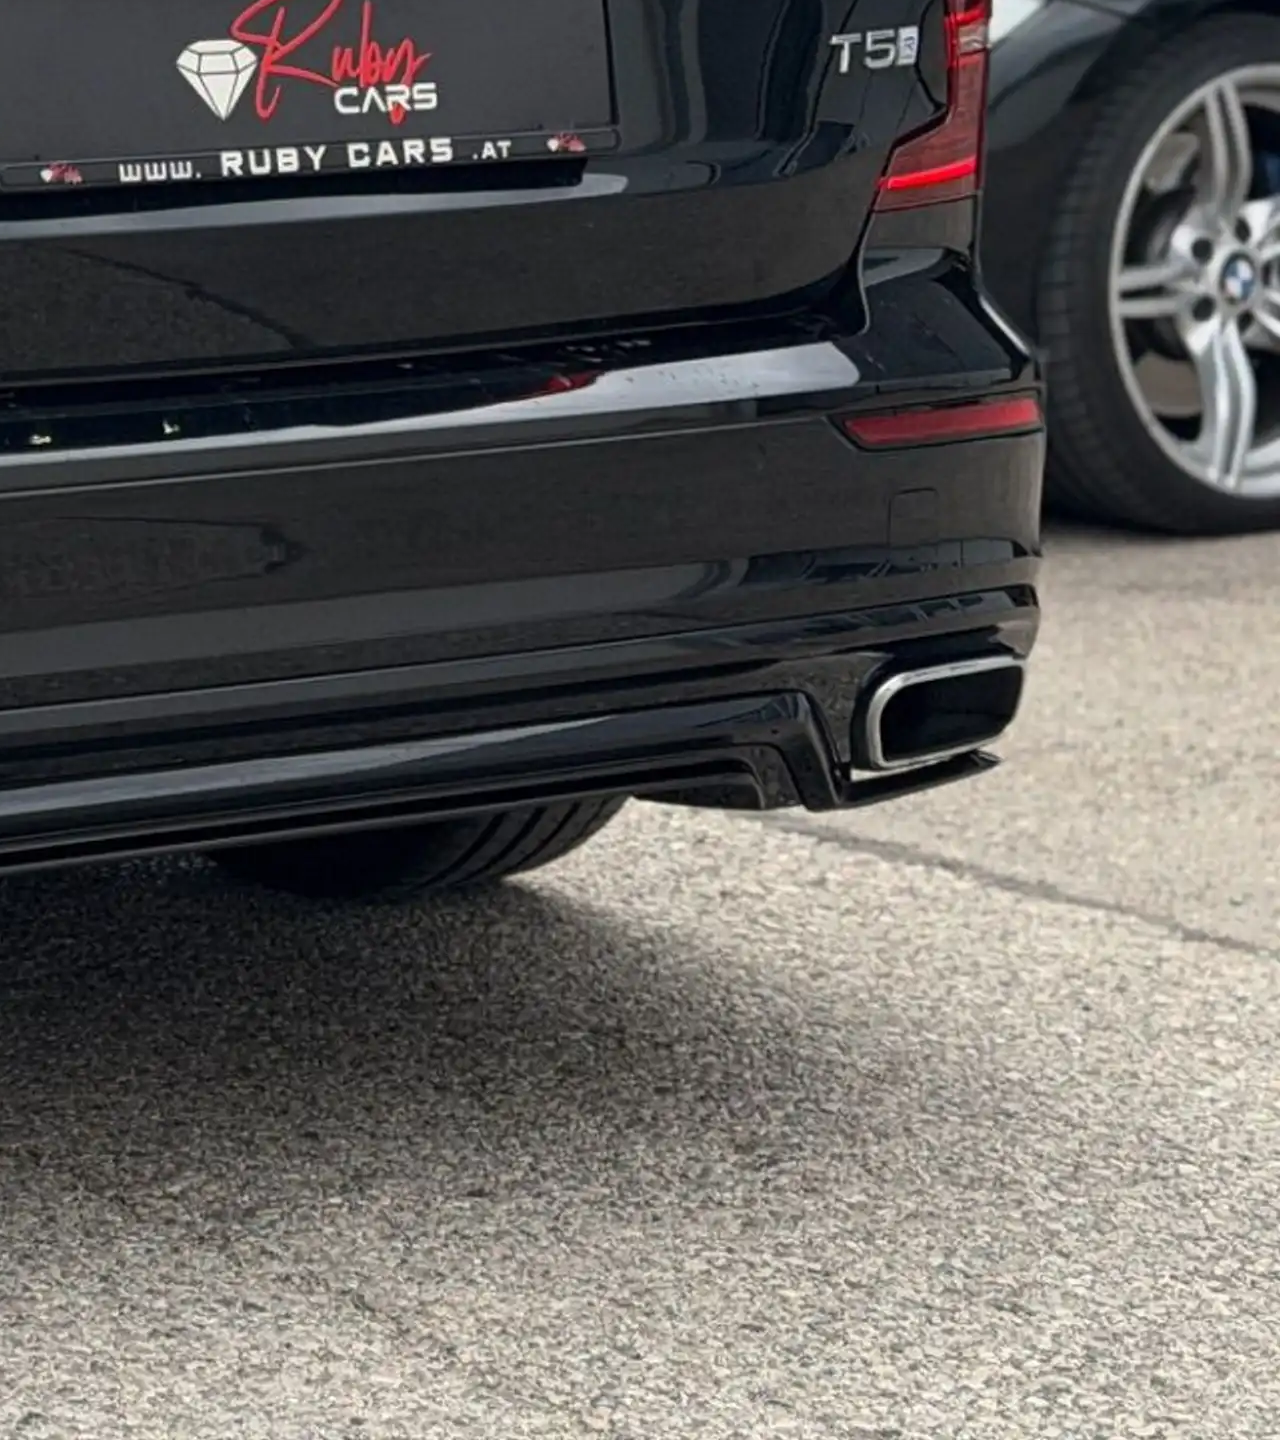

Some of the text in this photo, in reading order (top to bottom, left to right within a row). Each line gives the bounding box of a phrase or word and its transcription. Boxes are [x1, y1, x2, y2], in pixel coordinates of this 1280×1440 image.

[333, 81, 439, 115] CARS
[219, 145, 327, 177] RUBY
[346, 137, 454, 168] CARS
